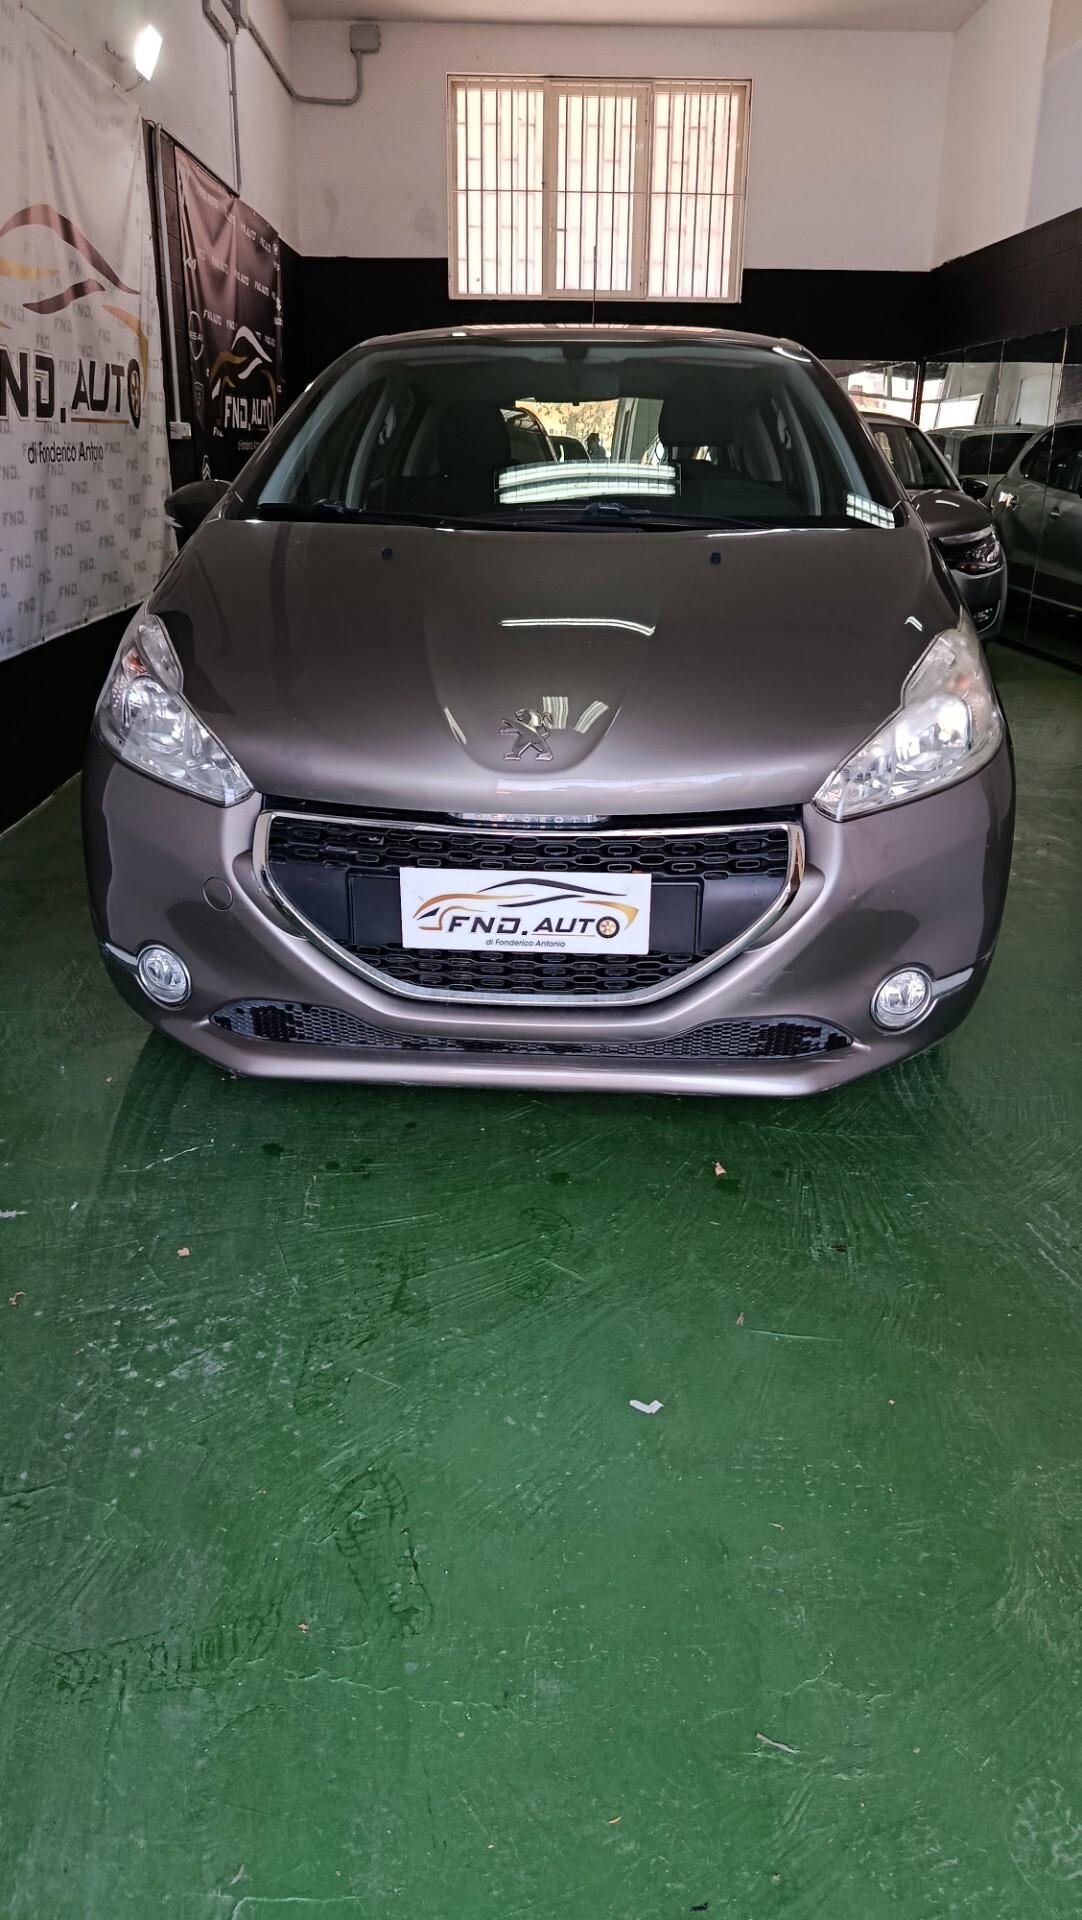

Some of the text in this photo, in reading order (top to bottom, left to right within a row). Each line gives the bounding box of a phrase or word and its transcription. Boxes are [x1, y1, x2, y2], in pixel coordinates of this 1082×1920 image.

[27, 441, 38, 464] di
[3, 509, 29, 528] FND.
[54, 543, 76, 560] FND.
[10, 553, 35, 573] FND.
[485, 938, 566, 948] di Fonderico Antonio
